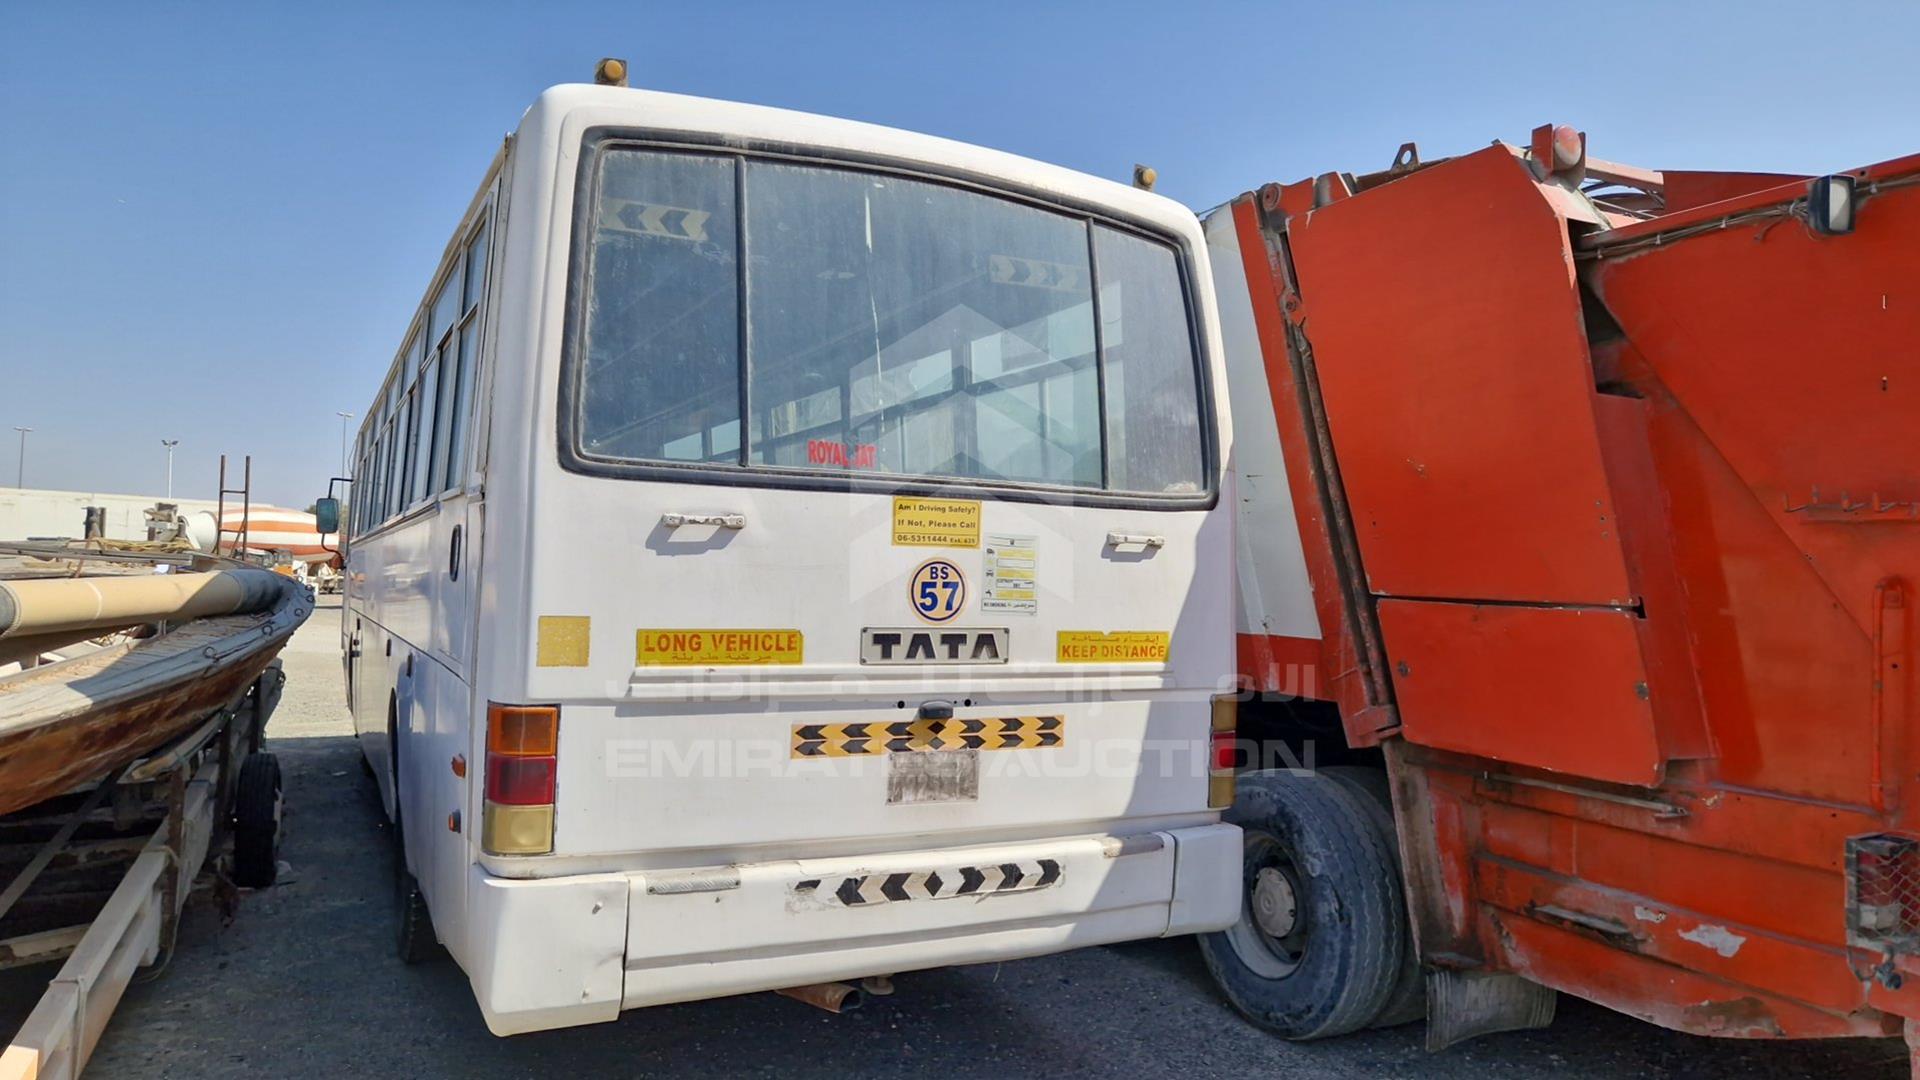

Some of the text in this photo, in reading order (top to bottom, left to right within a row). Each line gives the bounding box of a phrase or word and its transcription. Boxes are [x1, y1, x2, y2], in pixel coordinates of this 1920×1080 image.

[807, 440, 849, 467] ROYAL
[919, 504, 946, 513] Driving
[948, 506, 976, 514] Safely?
[928, 520, 957, 528] Please
[959, 521, 976, 529] Call
[930, 566, 949, 580] BS
[919, 581, 959, 612] 57
[644, 634, 797, 652] LONG VEHICLE
[872, 633, 999, 660] TATA
[1061, 645, 1165, 658] KEEP DISTANCE
